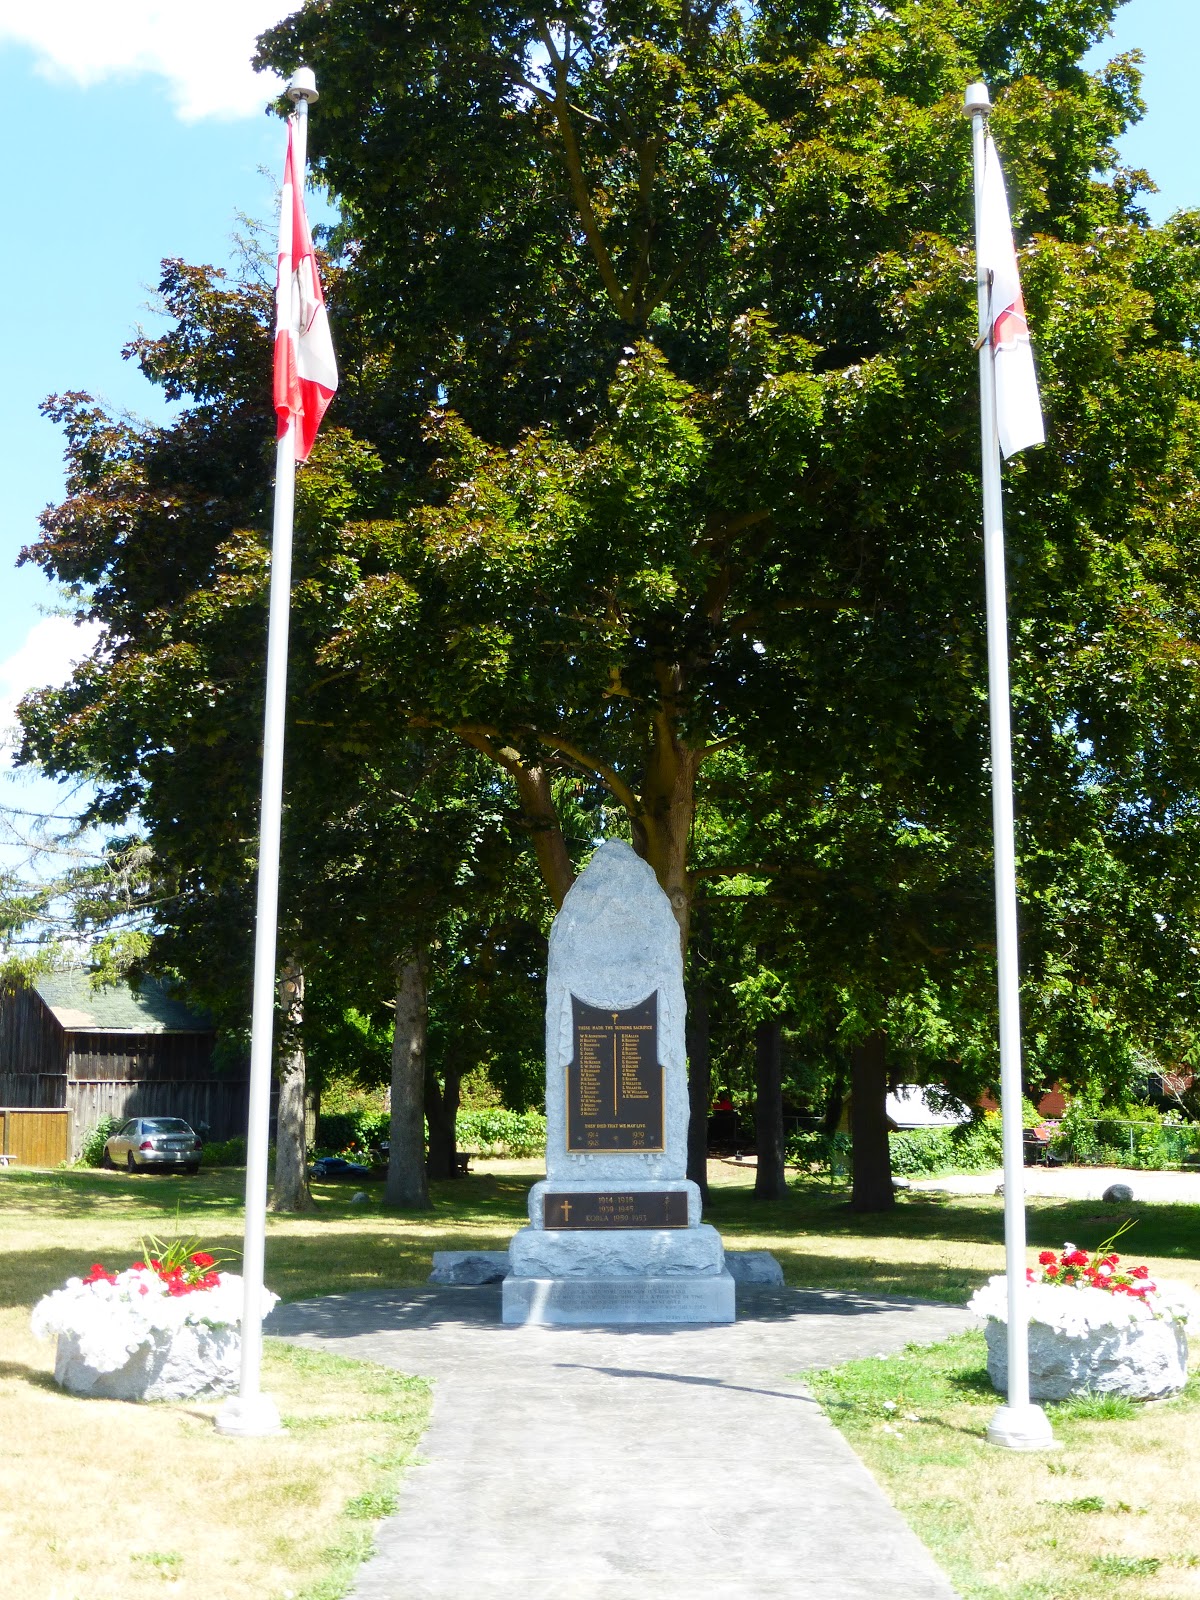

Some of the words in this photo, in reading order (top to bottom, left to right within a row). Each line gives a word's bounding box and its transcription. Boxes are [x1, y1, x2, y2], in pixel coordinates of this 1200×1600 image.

[598, 1196, 613, 1204] 1914
[585, 1214, 609, 1222] KOREA
[613, 1214, 629, 1222] 1950
